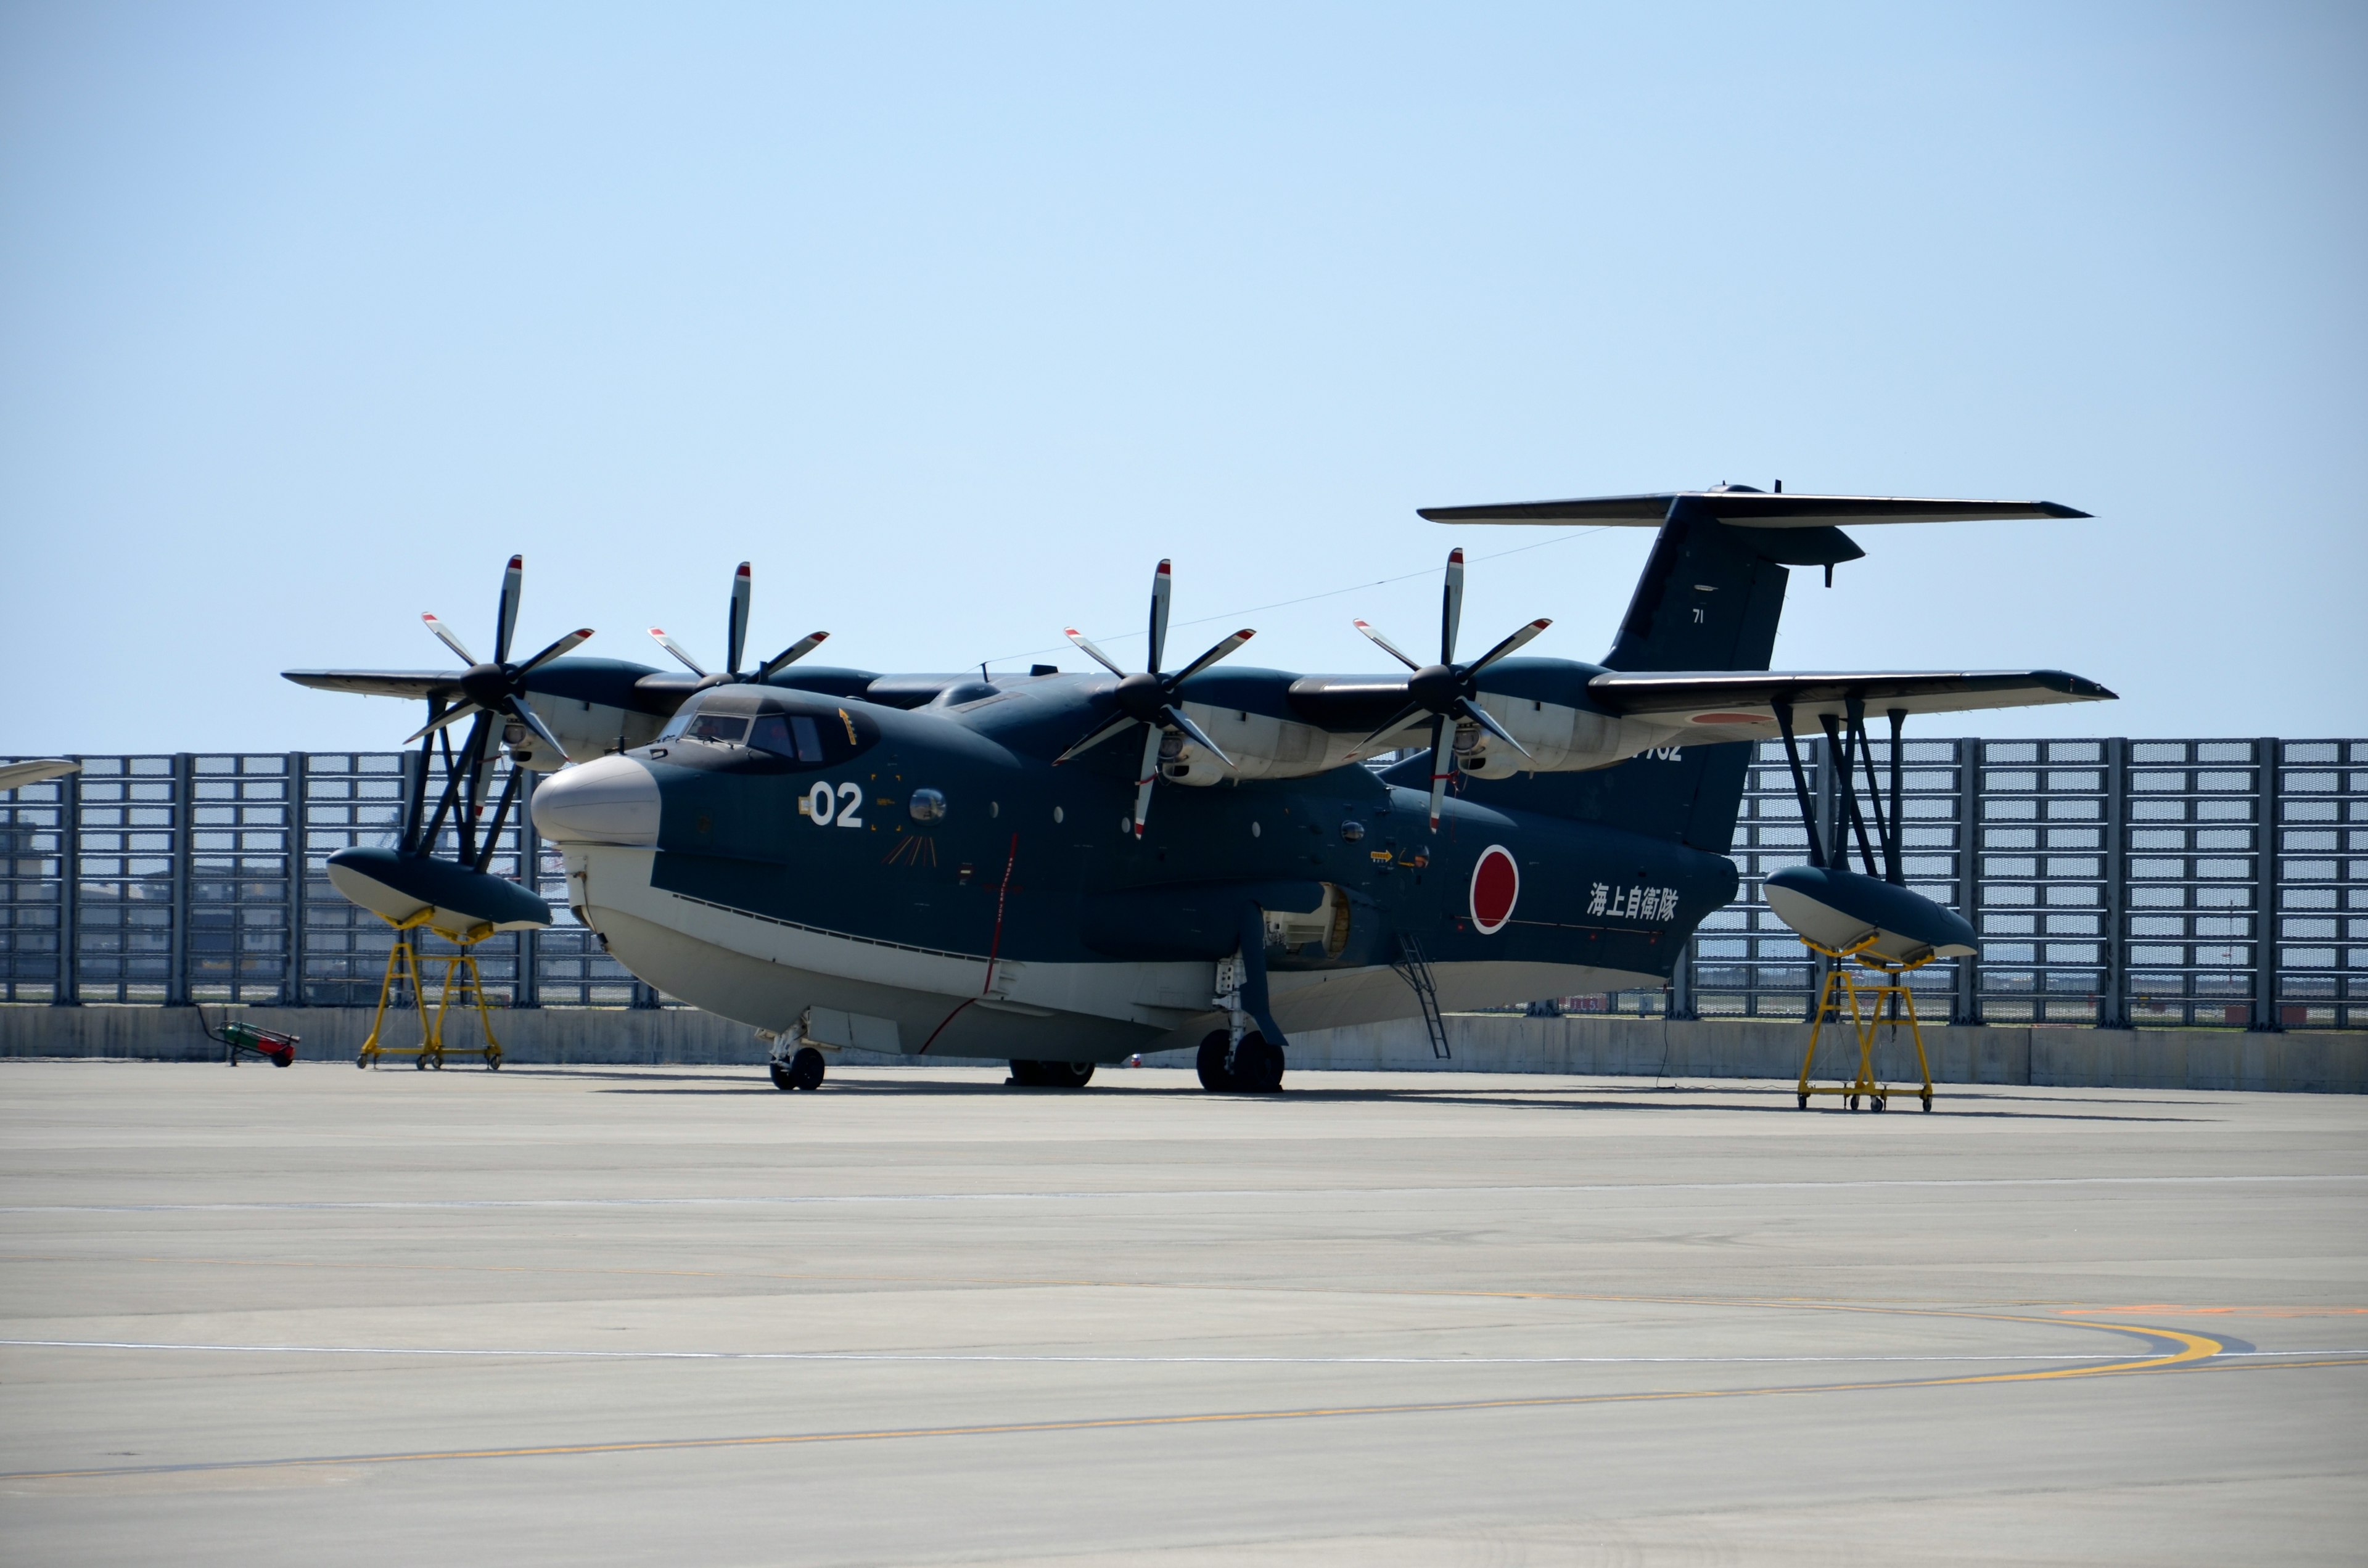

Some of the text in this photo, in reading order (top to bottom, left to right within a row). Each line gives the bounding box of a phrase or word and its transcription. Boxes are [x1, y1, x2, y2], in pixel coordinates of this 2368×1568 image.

[1693, 608, 1703, 623] 71
[810, 781, 862, 827] 02
[1587, 882, 1679, 921] 海上自衛隊
